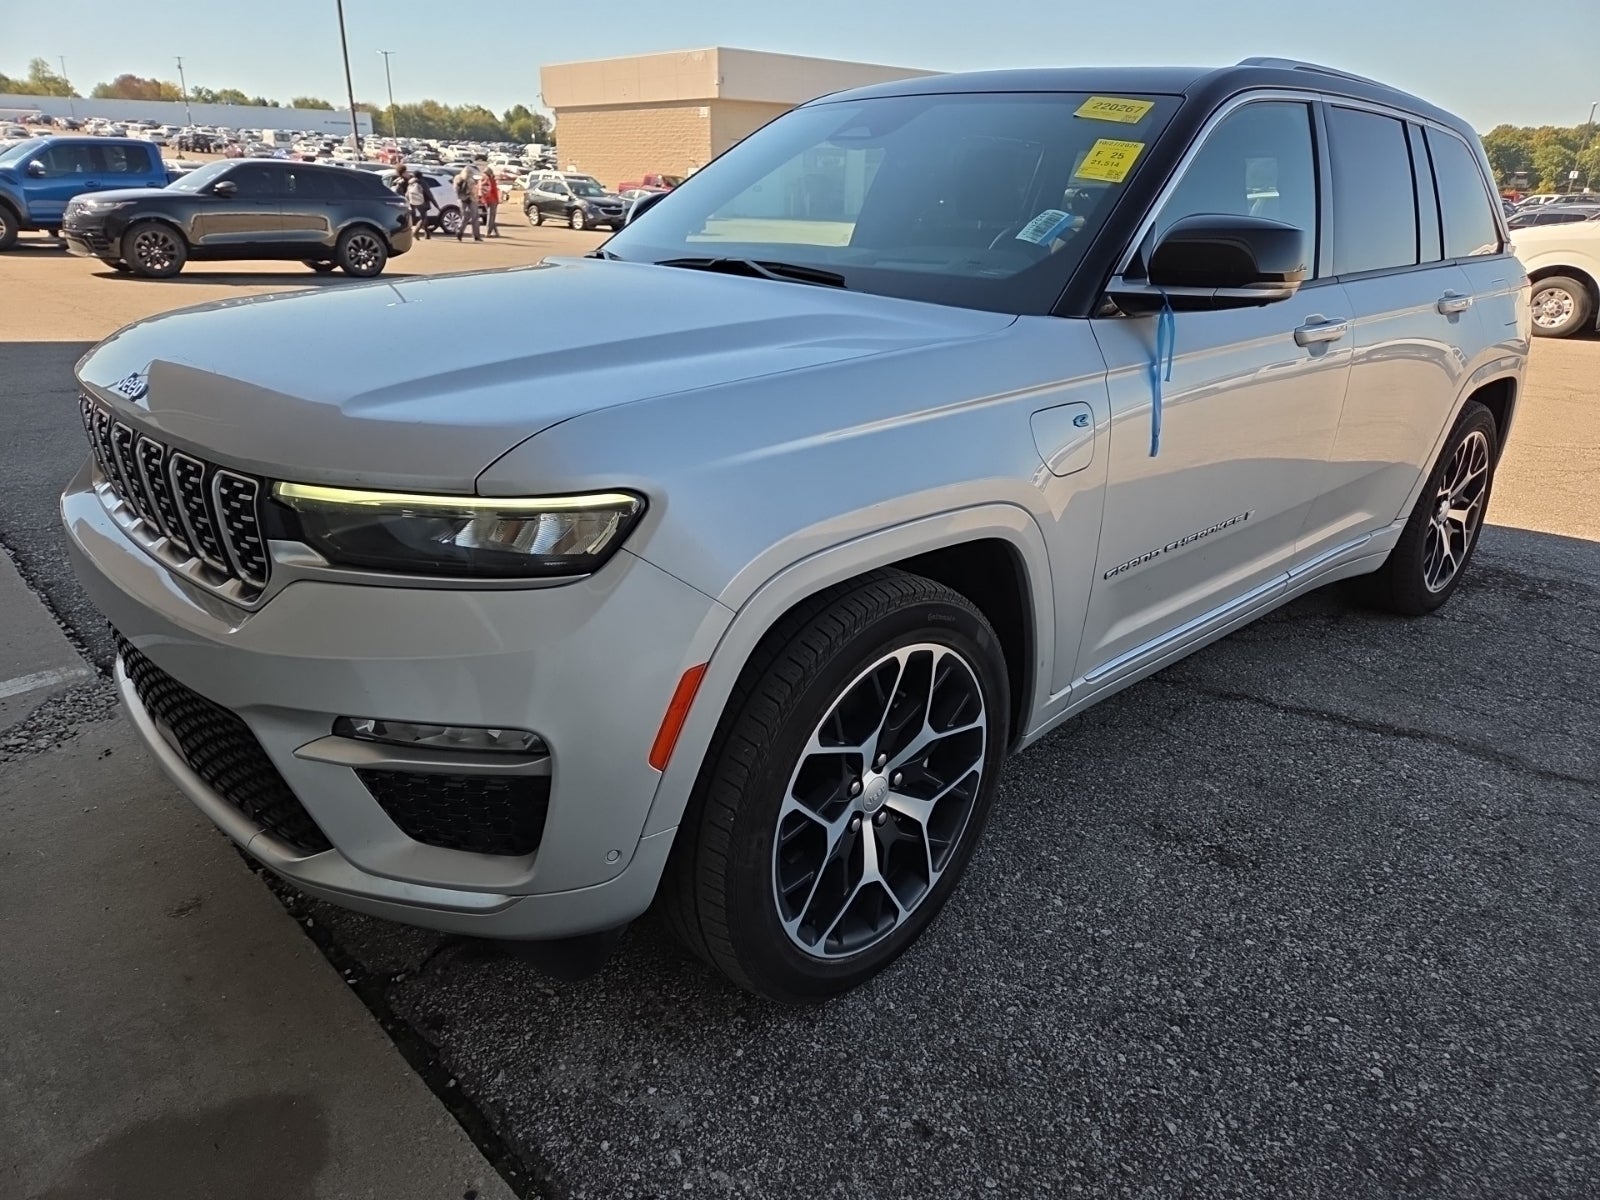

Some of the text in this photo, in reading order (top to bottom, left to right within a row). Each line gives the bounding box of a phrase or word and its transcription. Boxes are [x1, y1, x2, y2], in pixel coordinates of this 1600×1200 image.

[1092, 102, 1144, 113] 220267
[1110, 151, 1125, 160] 25
[1103, 510, 1255, 580] GRAND CHEROKEE
